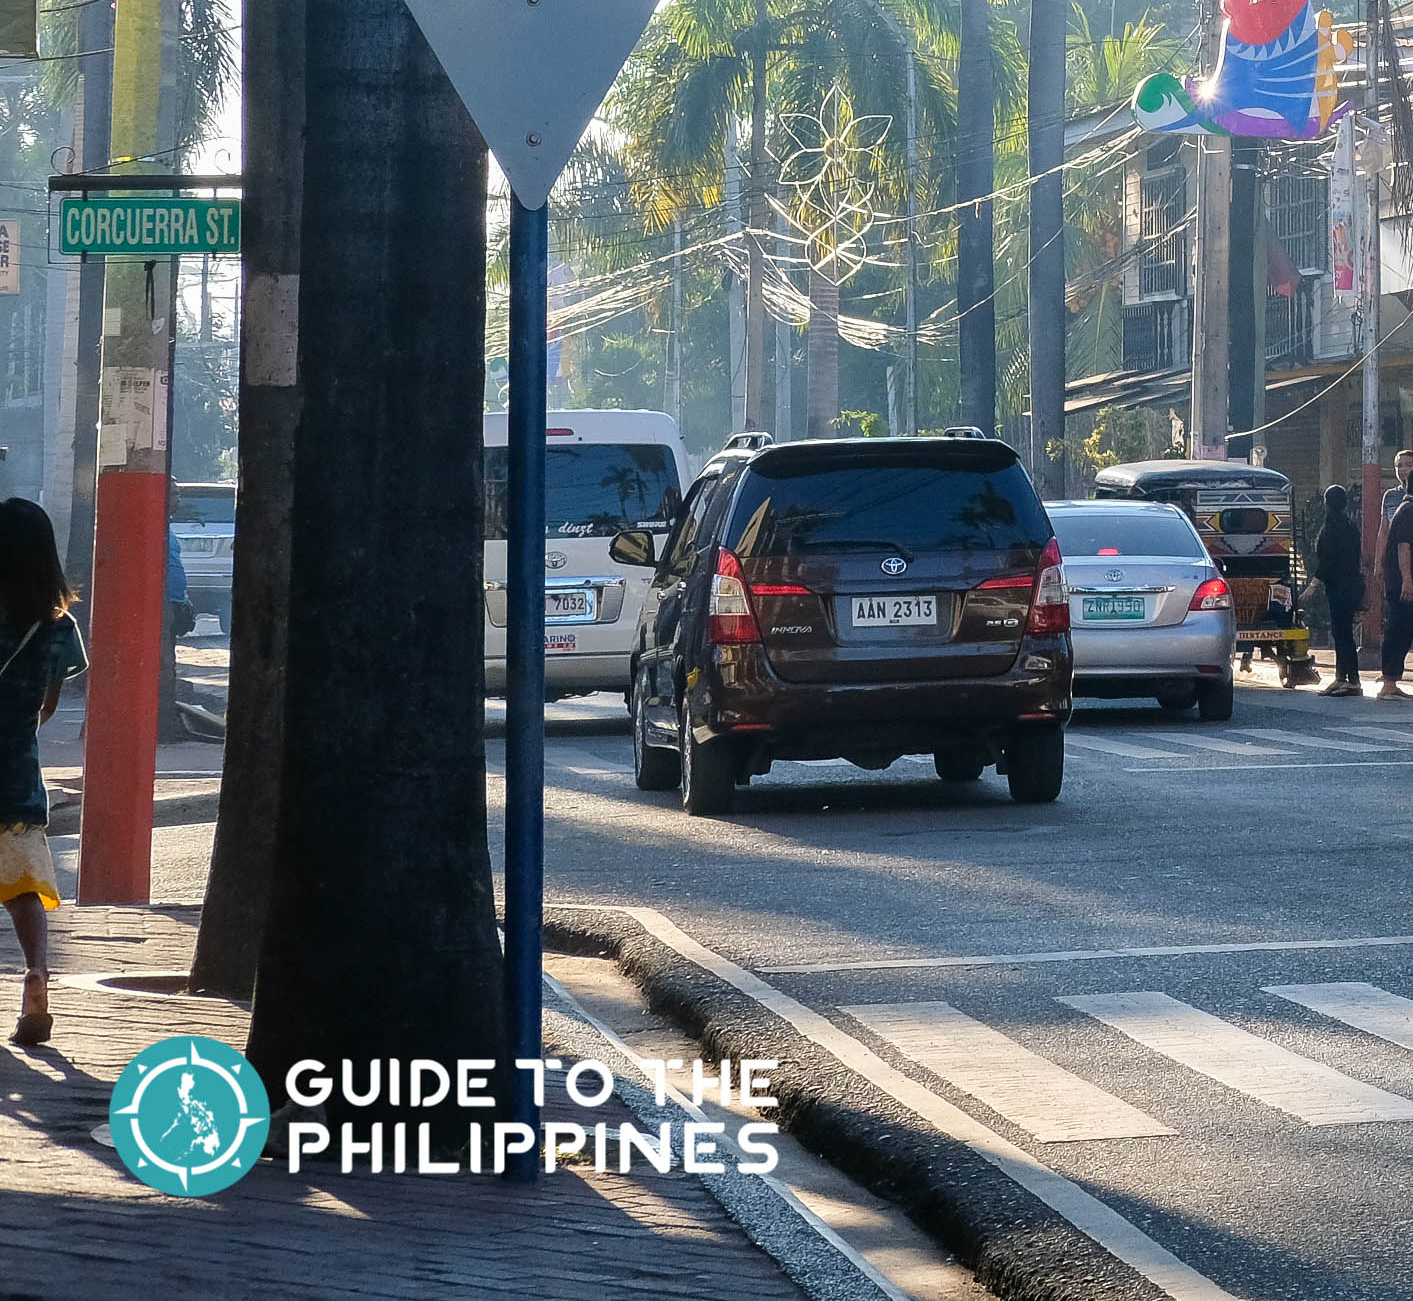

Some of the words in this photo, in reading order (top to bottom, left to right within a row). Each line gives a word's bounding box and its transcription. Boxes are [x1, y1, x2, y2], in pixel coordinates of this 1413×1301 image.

[66, 207, 199, 245] CORCUERRA
[206, 207, 235, 245] ST.
[555, 597, 585, 611] 7032
[856, 601, 887, 619] AAN
[893, 600, 933, 618] 2313
[1239, 632, 1285, 640] DISTANCE
